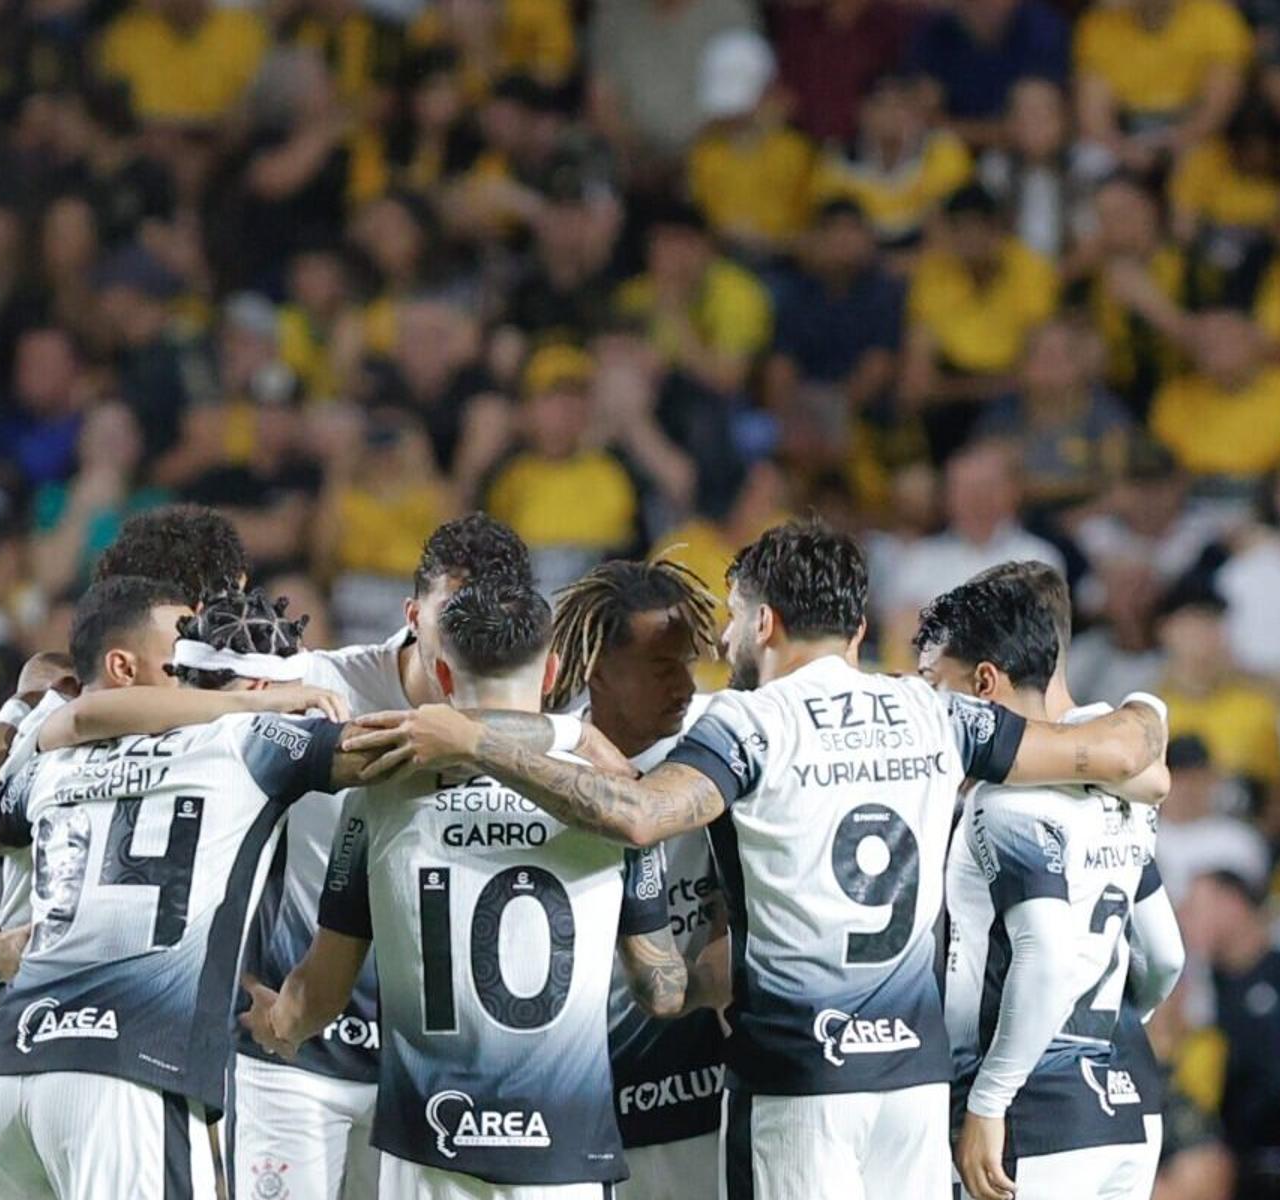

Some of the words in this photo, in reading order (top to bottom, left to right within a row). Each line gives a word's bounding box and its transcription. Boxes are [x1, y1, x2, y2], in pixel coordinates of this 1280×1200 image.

[804, 692, 907, 730] EZZE
[263, 721, 310, 760] bmg
[820, 729, 915, 752] SEGUROS
[54, 766, 169, 802] MEMPHIS
[435, 792, 542, 812] SEGURO
[443, 821, 548, 847] GARRO
[29, 795, 205, 957] 94
[832, 803, 920, 967] 9
[419, 865, 576, 1035] 10
[37, 1007, 118, 1031] AREA
[619, 1063, 726, 1114] FOXLUX
[456, 1110, 550, 1137] AREA
